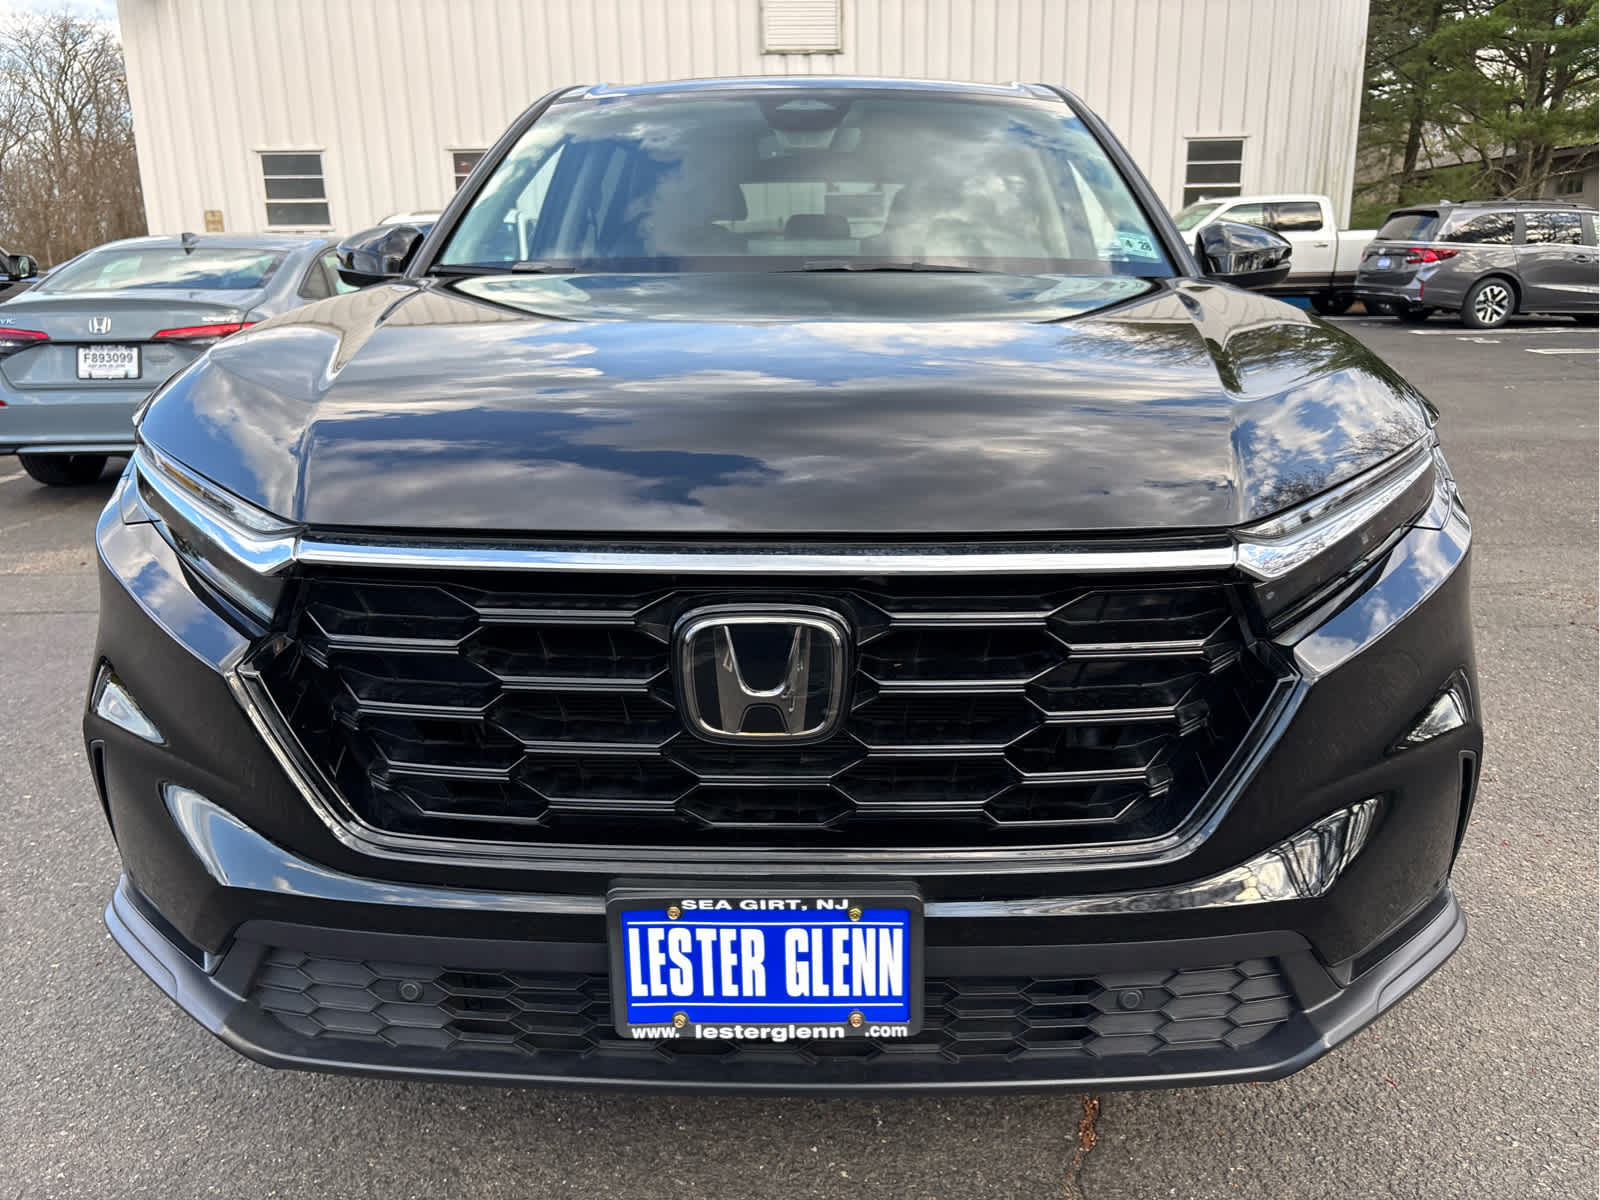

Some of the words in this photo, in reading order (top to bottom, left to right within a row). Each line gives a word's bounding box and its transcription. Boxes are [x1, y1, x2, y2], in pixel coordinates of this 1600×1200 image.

[83, 352, 133, 364] F893099
[681, 898, 732, 910] SEA
[739, 898, 808, 911] GIRT,
[816, 898, 849, 910] NJ
[629, 928, 766, 996] LESTER
[785, 928, 902, 996] GLENN
[632, 1026, 680, 1038] www.
[695, 1024, 845, 1042] lesterglenn
[864, 1024, 908, 1037] .com
